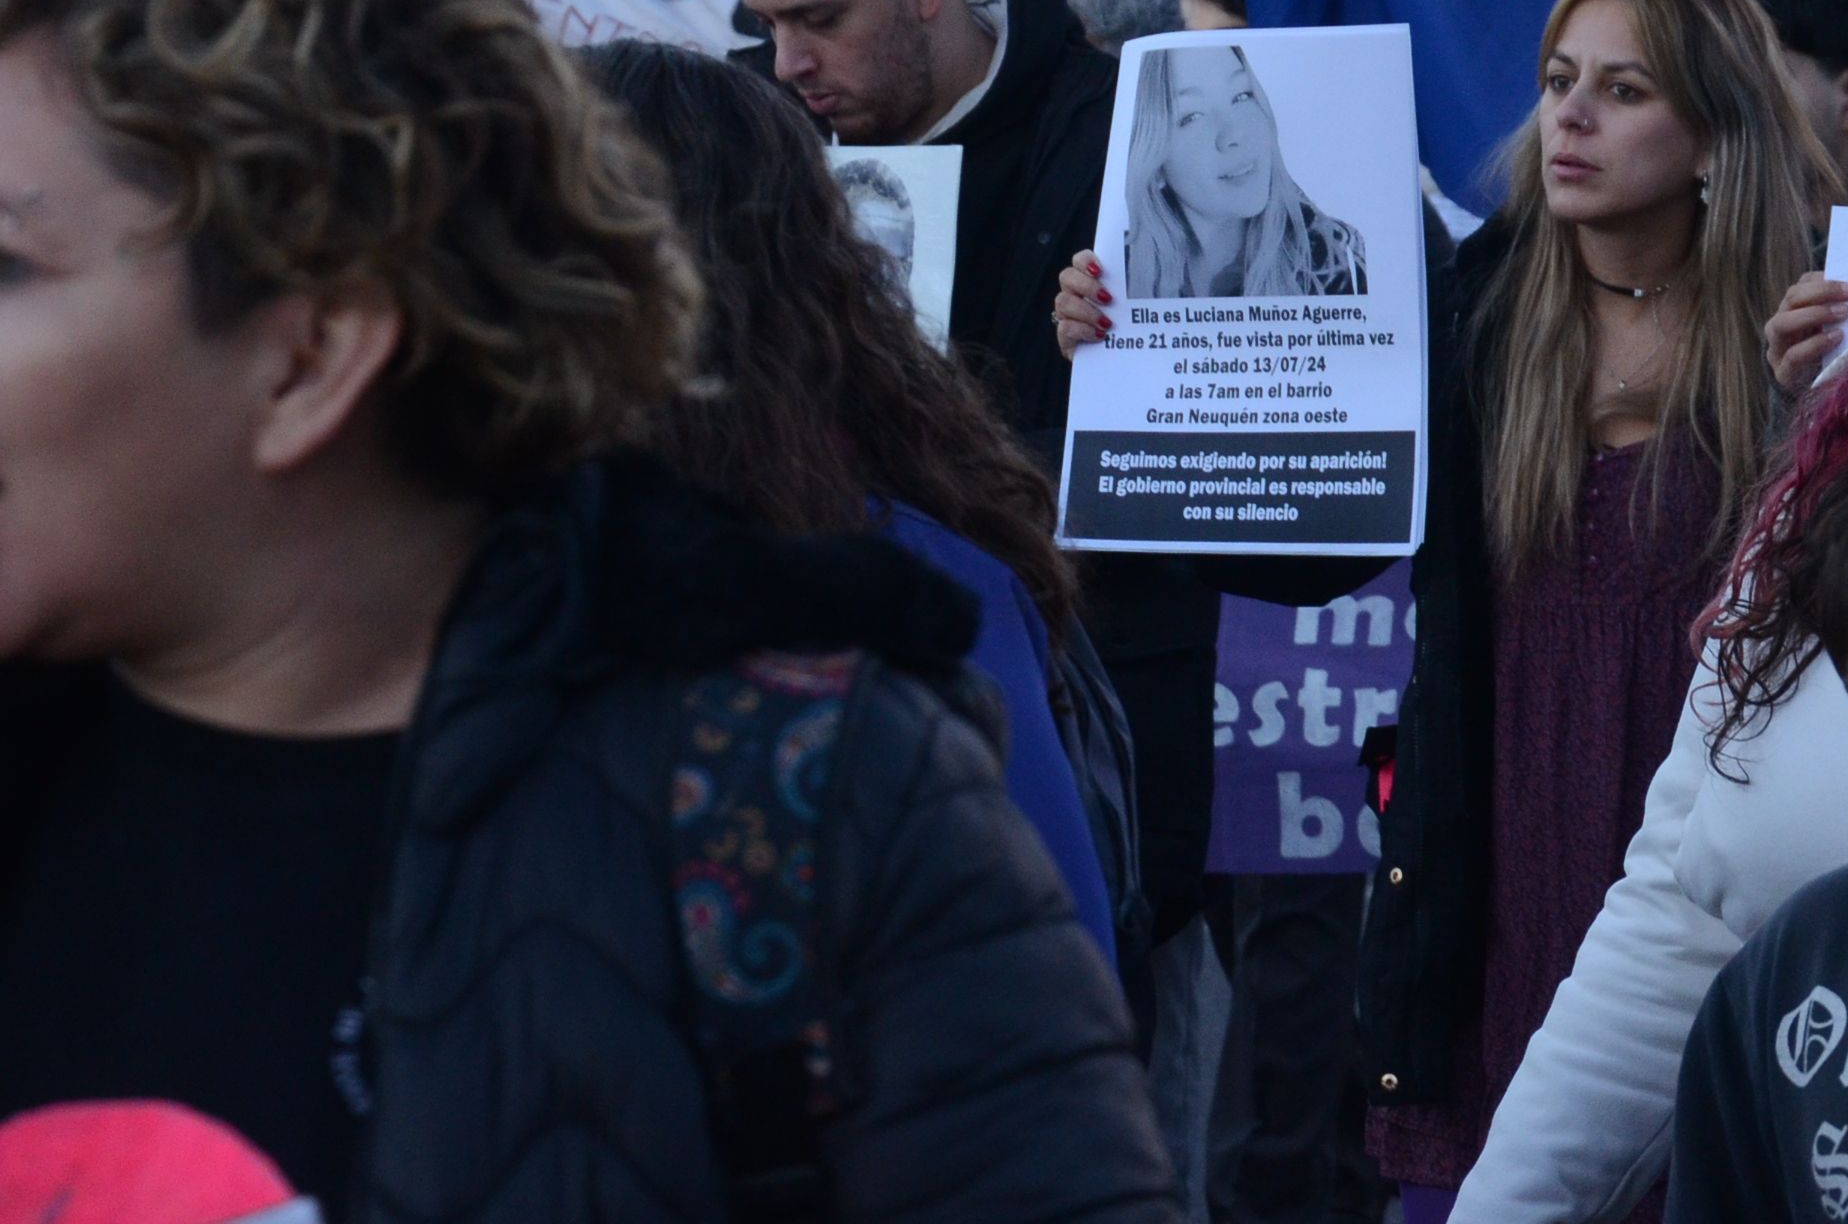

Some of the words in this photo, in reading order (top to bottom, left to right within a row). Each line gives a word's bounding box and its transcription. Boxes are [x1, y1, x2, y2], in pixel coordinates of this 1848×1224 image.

[1132, 308, 1158, 323] Ella
[1164, 311, 1180, 323] es
[1186, 307, 1243, 322] Luciana
[1249, 305, 1297, 321] Muñoz
[1303, 305, 1366, 324] Aguerre,
[1104, 334, 1144, 349] tiene
[1149, 333, 1167, 348] 21
[1172, 333, 1212, 350] años,
[1217, 332, 1241, 347] fue
[1247, 331, 1282, 347] vista
[1288, 335, 1312, 350] por
[1317, 330, 1364, 346] última
[1369, 333, 1394, 345] vez
[1174, 359, 1187, 374] el
[1193, 357, 1248, 373] sábado
[1254, 356, 1326, 374] 13/07/24
[1165, 388, 1174, 399] a
[1180, 384, 1202, 399] las
[1208, 384, 1239, 398] 7am
[1245, 387, 1263, 398] en
[1268, 383, 1281, 398] el
[1287, 382, 1332, 397] barrio
[1147, 408, 1183, 423] Gran
[1189, 409, 1258, 427] Neuquén
[1263, 412, 1299, 423] zona
[1305, 408, 1347, 423] oeste
[1100, 450, 1176, 471] Seguimos
[1180, 452, 1256, 472] exigiendo
[1259, 456, 1285, 472] por
[1289, 456, 1306, 469] su
[1310, 451, 1387, 472] aparición!
[1099, 476, 1113, 492] El
[1116, 476, 1186, 496] gobierno
[1189, 477, 1265, 497] provincial
[1269, 482, 1287, 495] es
[1291, 478, 1385, 498] responsable
[1183, 507, 1211, 519] con
[1215, 507, 1234, 520] su
[1237, 503, 1298, 520] silencio
